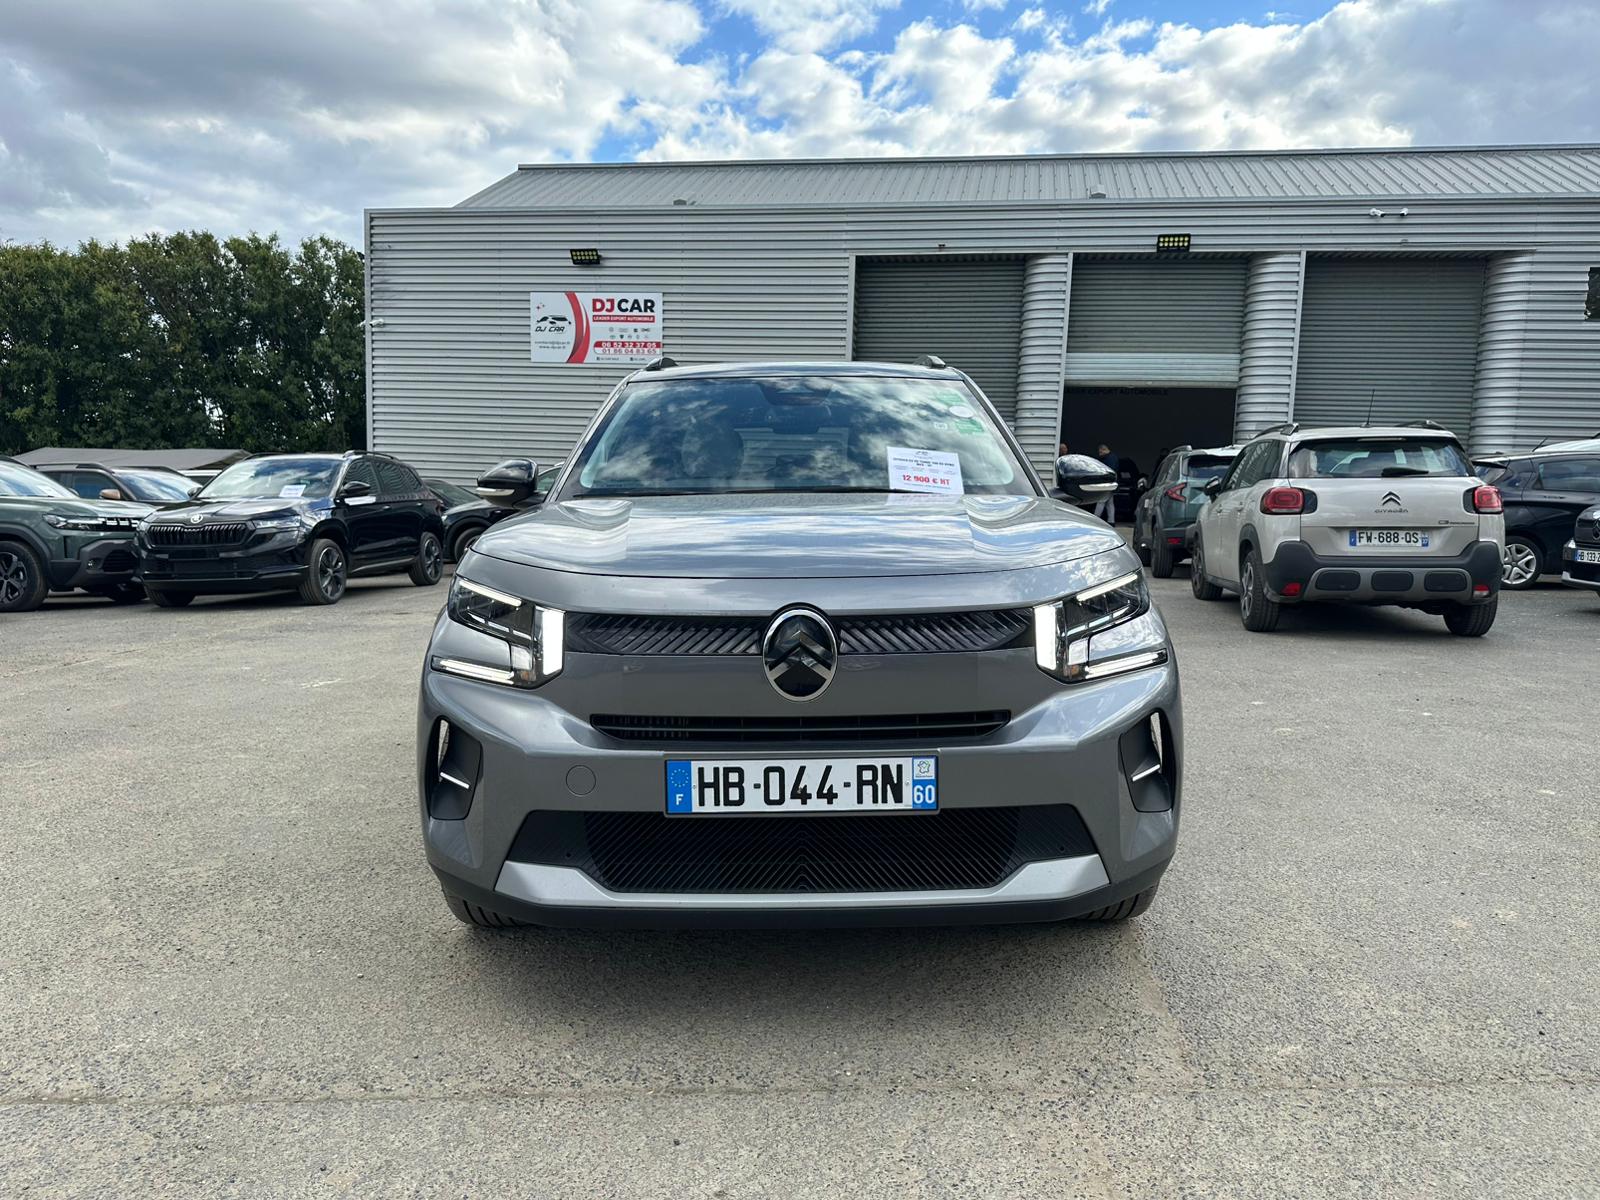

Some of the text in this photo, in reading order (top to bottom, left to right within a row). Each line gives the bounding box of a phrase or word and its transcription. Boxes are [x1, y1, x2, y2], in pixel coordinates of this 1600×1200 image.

[592, 298, 655, 313] DJ CAR
[914, 475, 929, 483] 900
[1358, 532, 1419, 544] FW-688-QS
[698, 764, 904, 807] HB-044-RN
[675, 794, 684, 806] F
[913, 785, 935, 805] 60
